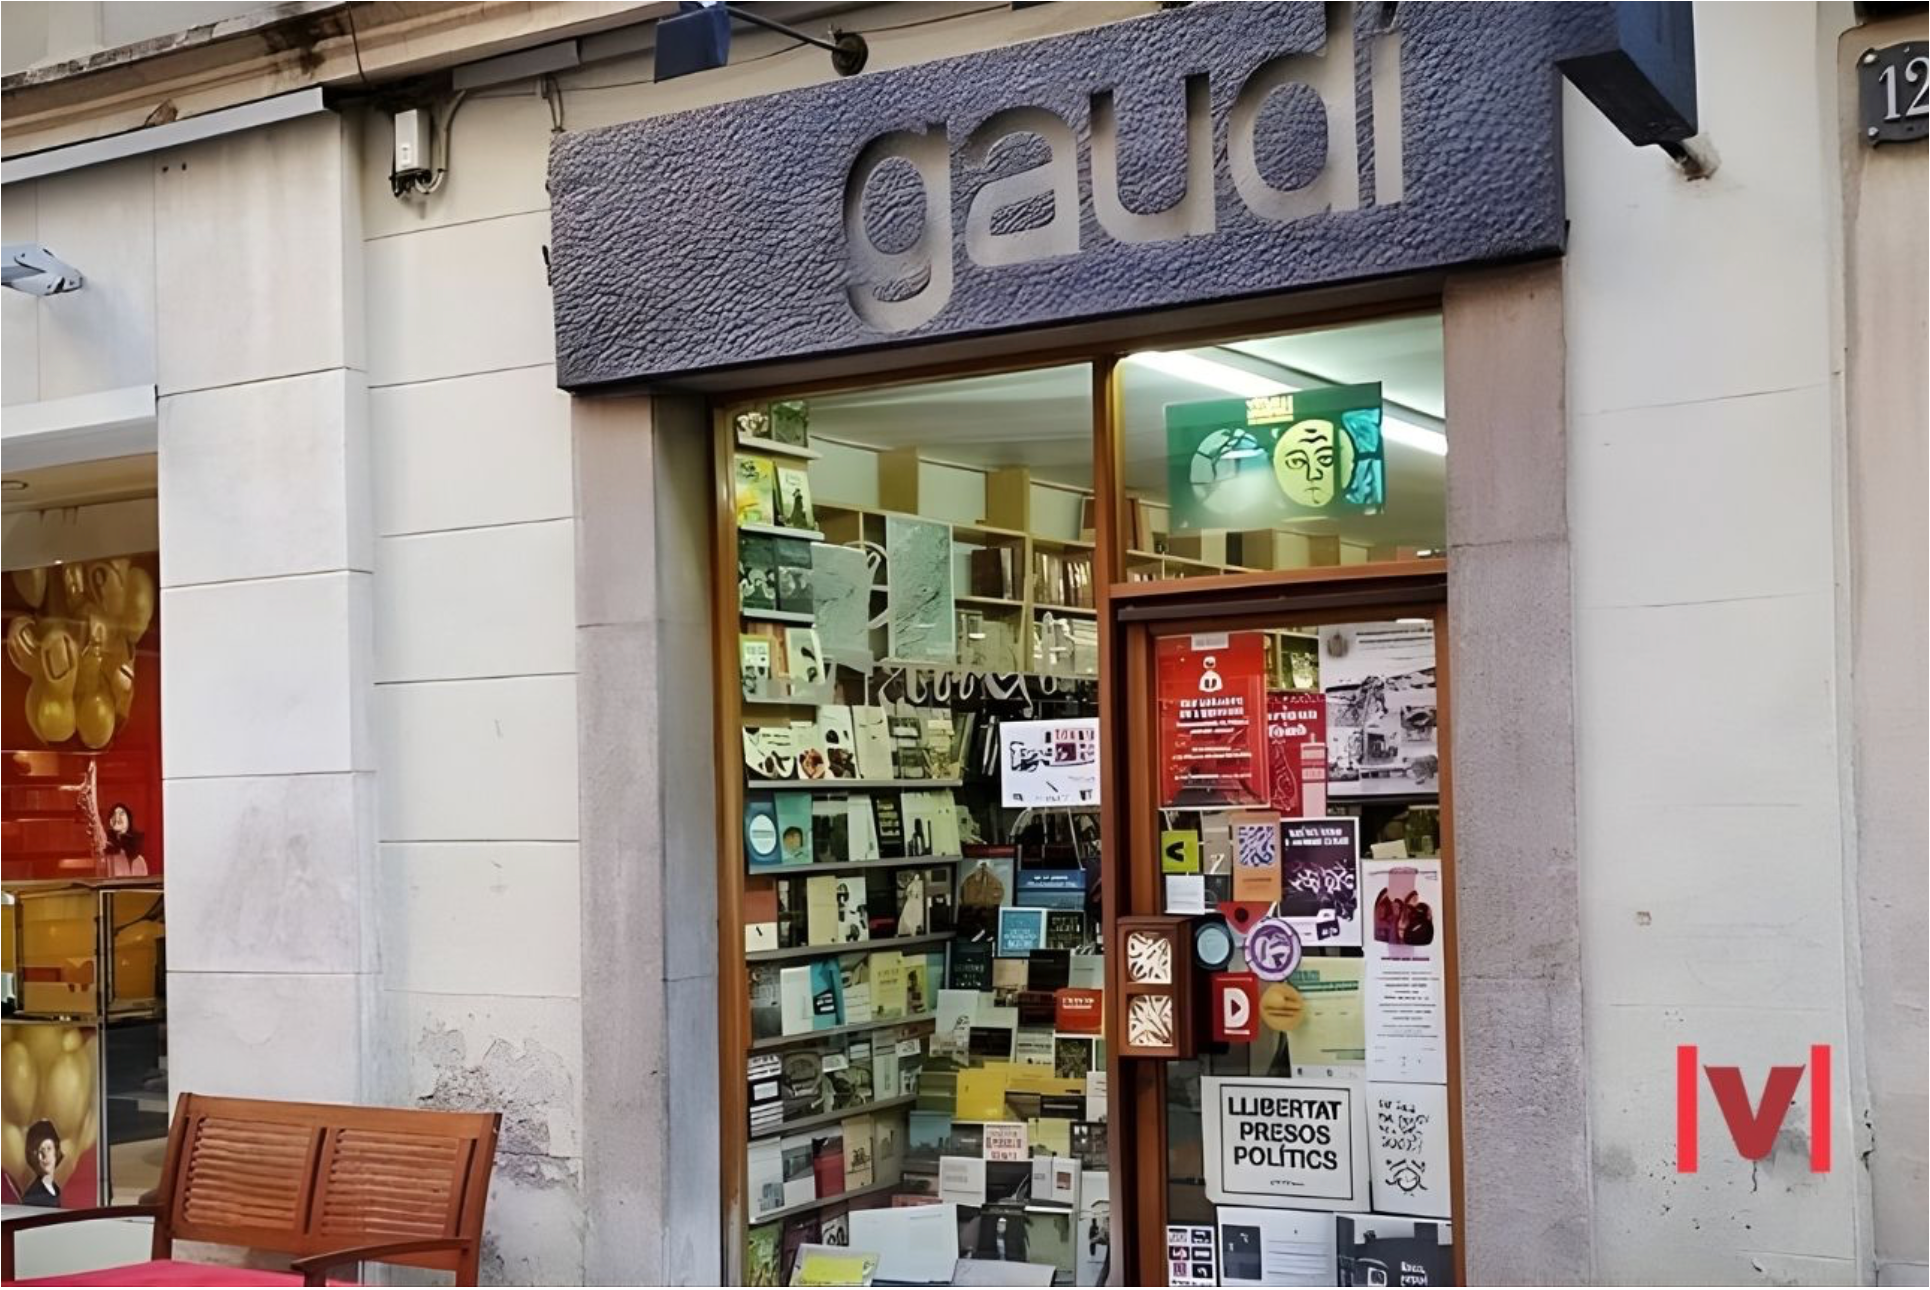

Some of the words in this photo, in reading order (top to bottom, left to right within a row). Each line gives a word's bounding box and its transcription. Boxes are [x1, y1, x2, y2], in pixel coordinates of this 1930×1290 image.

[1878, 56, 1929, 120] 12
[1228, 1096, 1342, 1120] LLIBERTAT
[1240, 1121, 1331, 1145] PRESOS
[1233, 1143, 1338, 1170] POLÍTICS
